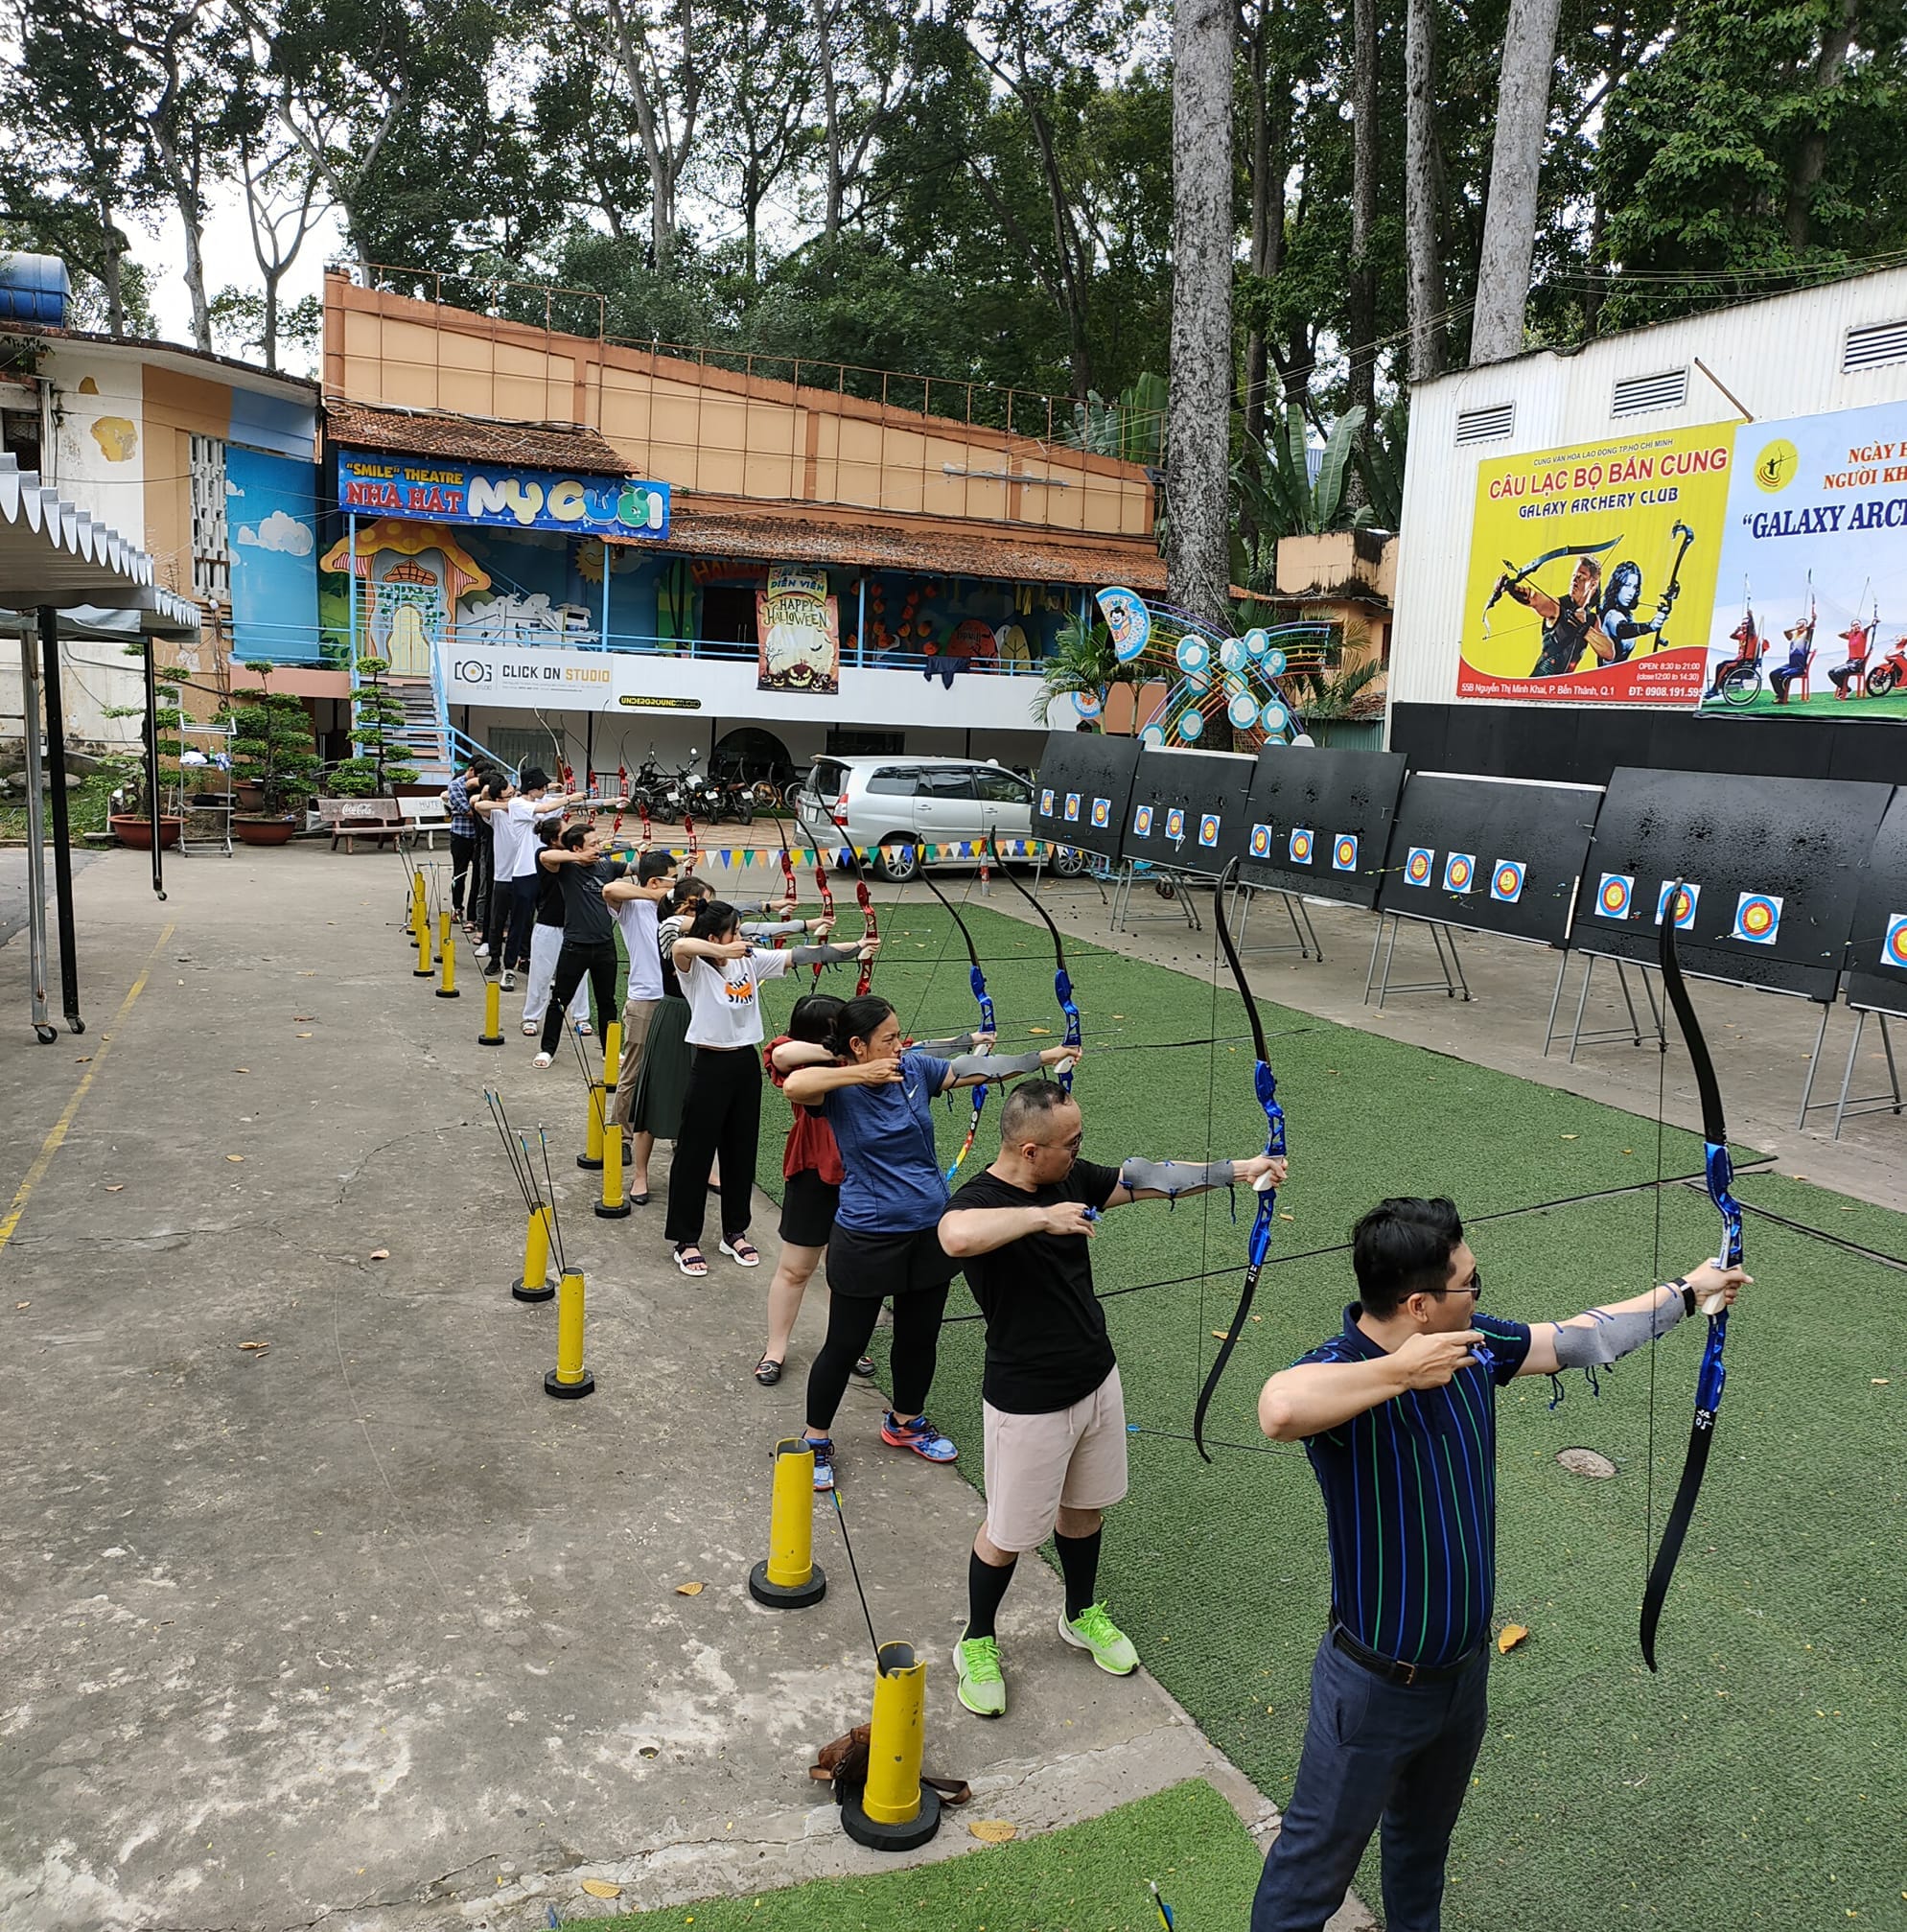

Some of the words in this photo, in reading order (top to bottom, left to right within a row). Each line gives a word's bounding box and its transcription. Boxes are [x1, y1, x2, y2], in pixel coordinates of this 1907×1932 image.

[1655, 438, 1674, 448] MINH
[1849, 440, 1895, 463] NGÀY
[404, 468, 463, 485] THEATRE
[1489, 474, 1525, 500] CÂU
[1530, 470, 1568, 497] LẠC
[1573, 461, 1603, 491] BỘ
[1608, 455, 1653, 484] BẮN
[1661, 448, 1728, 477] CUNG
[1824, 465, 1878, 489] NGƯỜI
[346, 481, 403, 508] NHÀ
[407, 485, 463, 513] HÁT
[1519, 500, 1567, 519] GALAXY
[1571, 492, 1635, 514] ARCHERY
[1640, 487, 1678, 504] CLUB
[1743, 504, 1846, 539] “GALAXY
[779, 597, 816, 612] HAPPY
[763, 604, 831, 629] HALLOWEEN
[502, 664, 539, 679] CLICK
[544, 667, 561, 680] ON
[565, 668, 611, 683] STUDIO
[1512, 683, 1528, 693] Minh
